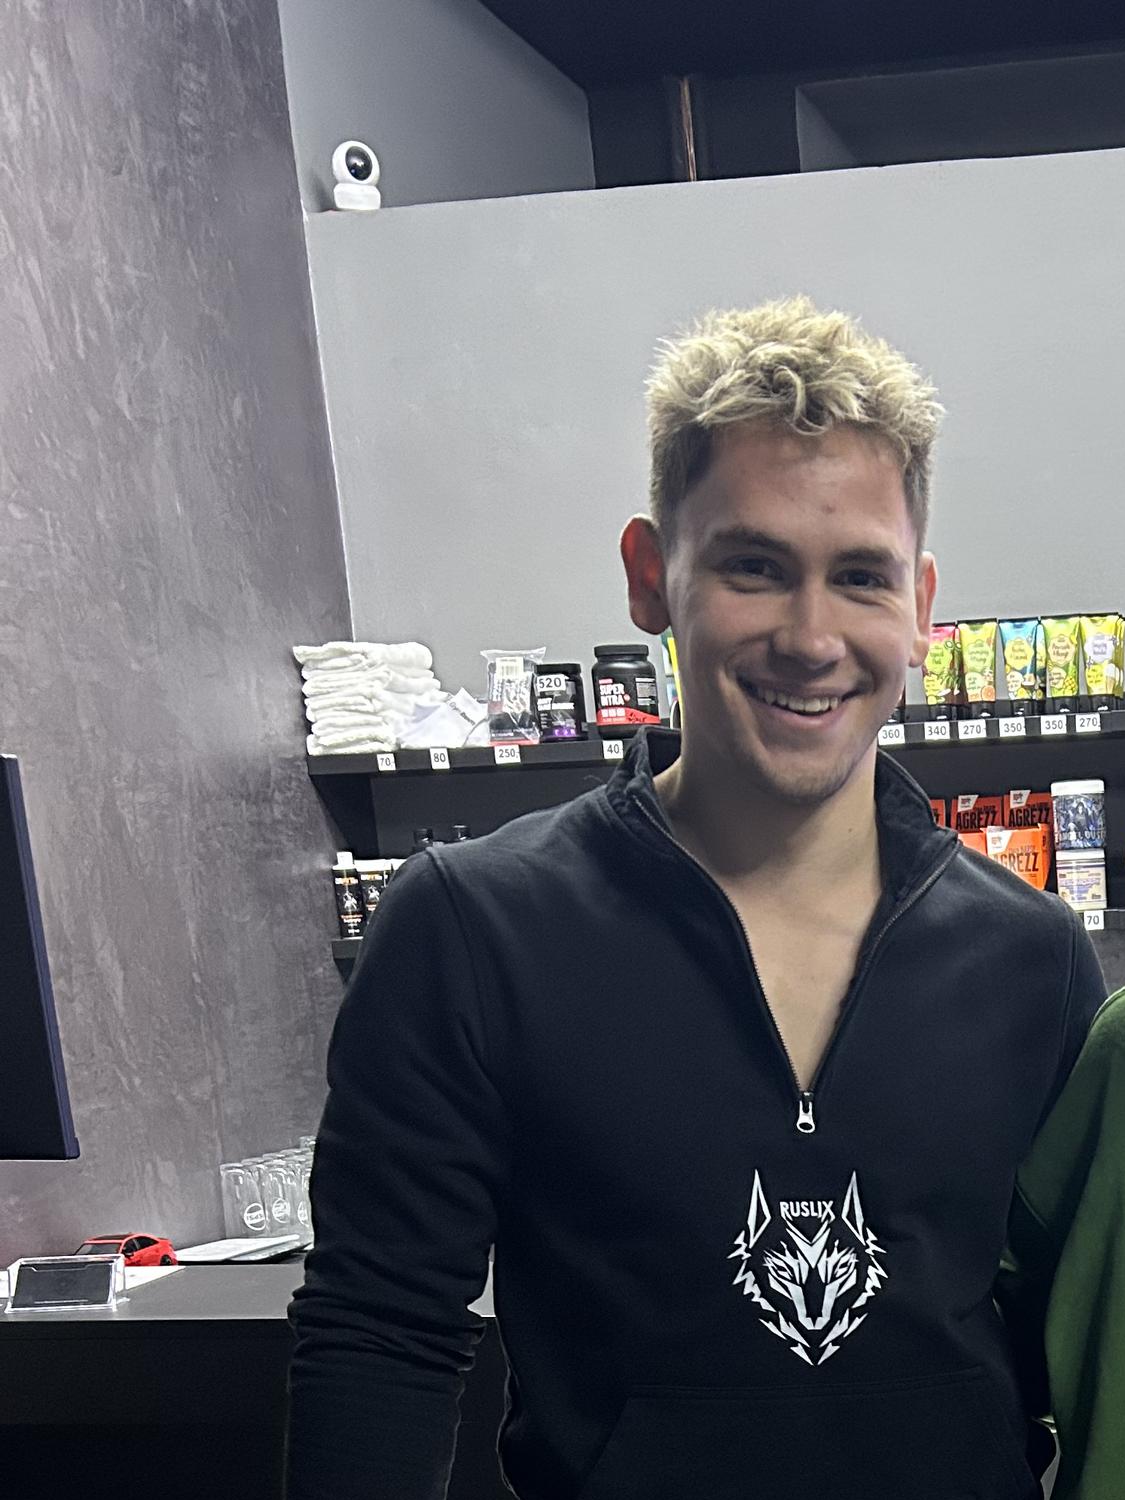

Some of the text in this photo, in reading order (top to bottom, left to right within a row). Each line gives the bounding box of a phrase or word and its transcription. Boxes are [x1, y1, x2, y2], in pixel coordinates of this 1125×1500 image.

[537, 677, 562, 689] 520
[955, 808, 998, 831] AGREZZ
[779, 1201, 836, 1223] RUSLIX
